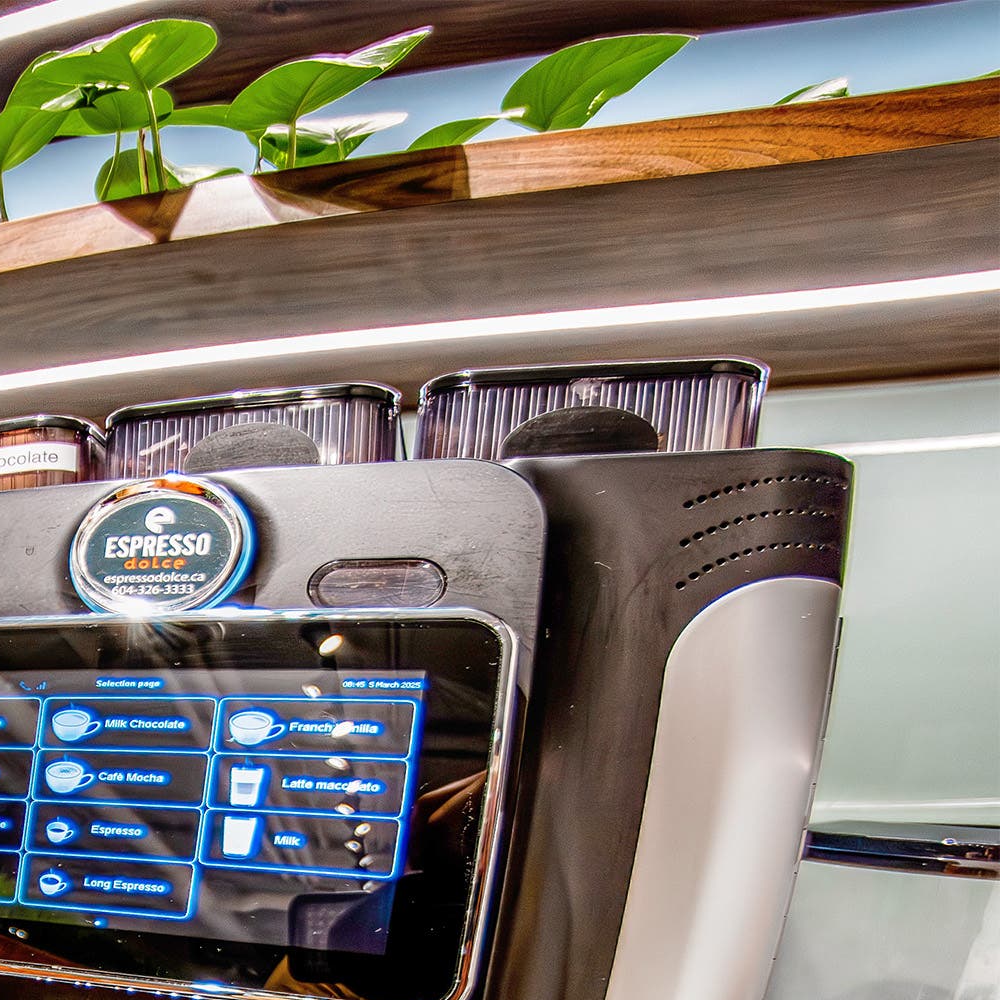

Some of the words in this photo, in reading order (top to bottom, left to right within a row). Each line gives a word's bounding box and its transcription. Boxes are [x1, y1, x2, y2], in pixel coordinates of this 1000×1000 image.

[104, 532, 212, 558] ESPRESSO
[103, 572, 206, 585] espressodolce.ca
[111, 584, 195, 595] 604-326-3333
[95, 680, 136, 688] Selection
[137, 680, 160, 689] page
[375, 681, 400, 689] March
[400, 681, 421, 689] 2025
[104, 719, 127, 728] Milk
[129, 719, 186, 729] Chocolate
[126, 772, 164, 783] Mocha
[281, 778, 313, 789] Latte
[90, 824, 142, 837] Espresso
[273, 835, 301, 847] Milk
[83, 877, 111, 890] Long
[113, 879, 166, 893] Espresso
